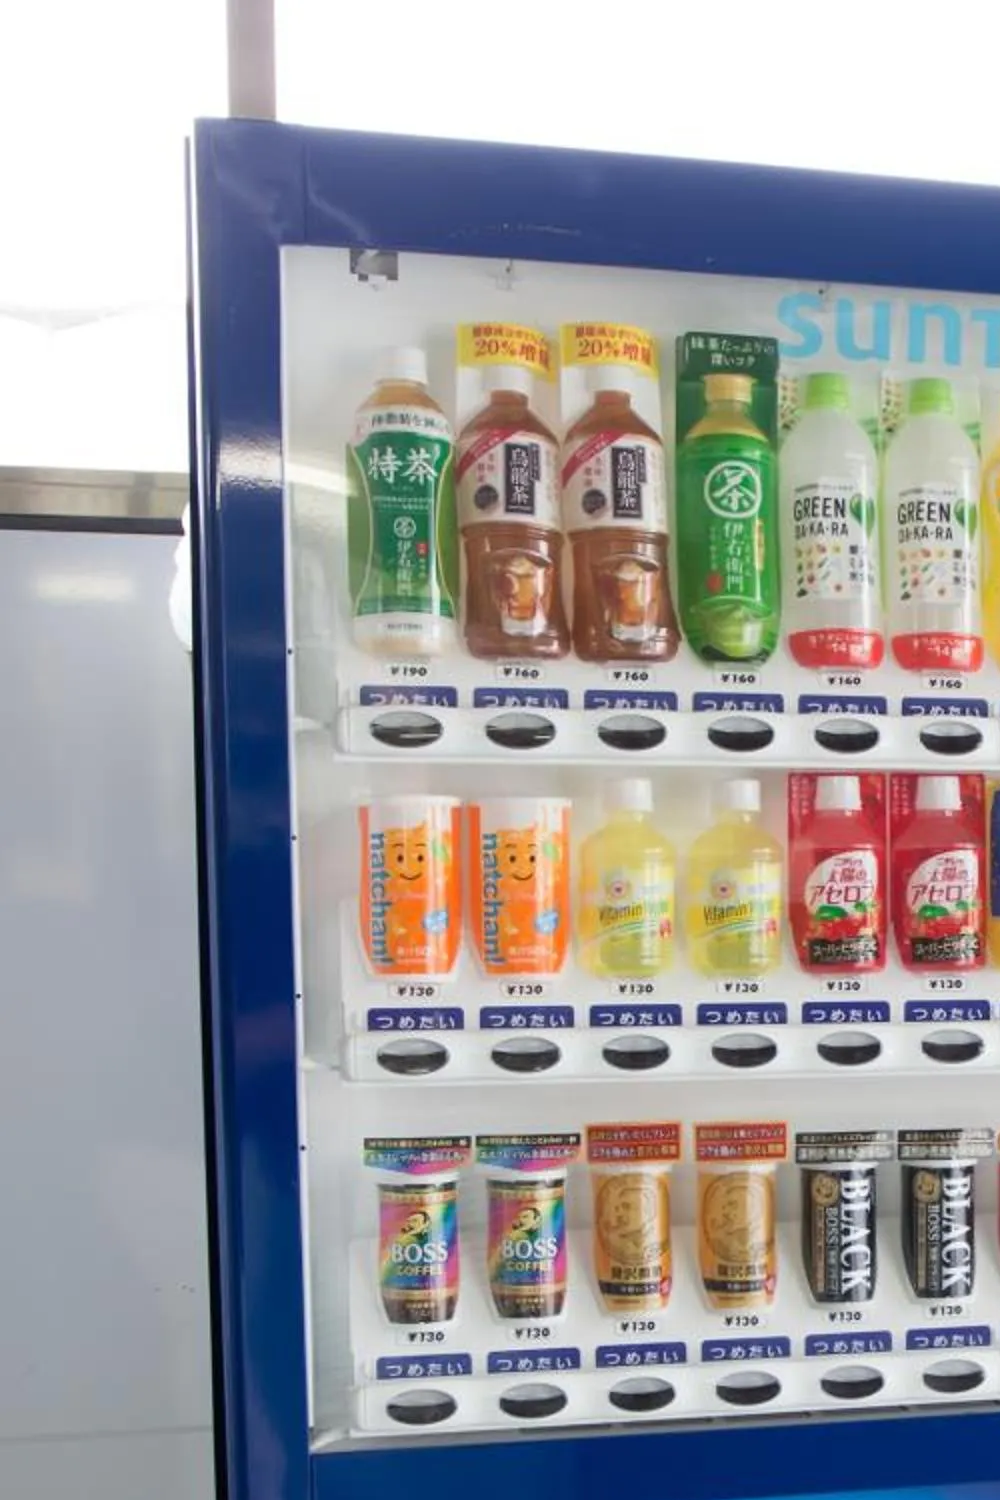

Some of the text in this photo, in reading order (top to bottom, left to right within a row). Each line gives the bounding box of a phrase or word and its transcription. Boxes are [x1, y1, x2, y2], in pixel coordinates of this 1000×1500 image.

[368, 446, 439, 484] 特茶
[794, 496, 846, 521] GREEN
[897, 501, 951, 525] GREEN
[371, 832, 395, 964] natchan!
[483, 833, 507, 964] natchan!
[489, 1015, 566, 1027] つめたい
[600, 1013, 674, 1026] つめたい
[706, 1011, 780, 1024] つめたい
[810, 1009, 883, 1021] つめたい
[912, 1008, 984, 1020] つめたい
[376, 1016, 455, 1029] つめたい
[841, 1179, 871, 1294] BLACK
[942, 1176, 972, 1290] BLACK
[391, 1243, 448, 1263] BOSS
[503, 1237, 557, 1259] BOSS
[814, 1340, 885, 1354] つめたい
[914, 1334, 984, 1348] つめたい
[605, 1350, 680, 1365] つめたい
[711, 1345, 783, 1359] つめたい
[386, 1362, 463, 1377] つめたい
[497, 1357, 573, 1371] つめたい
